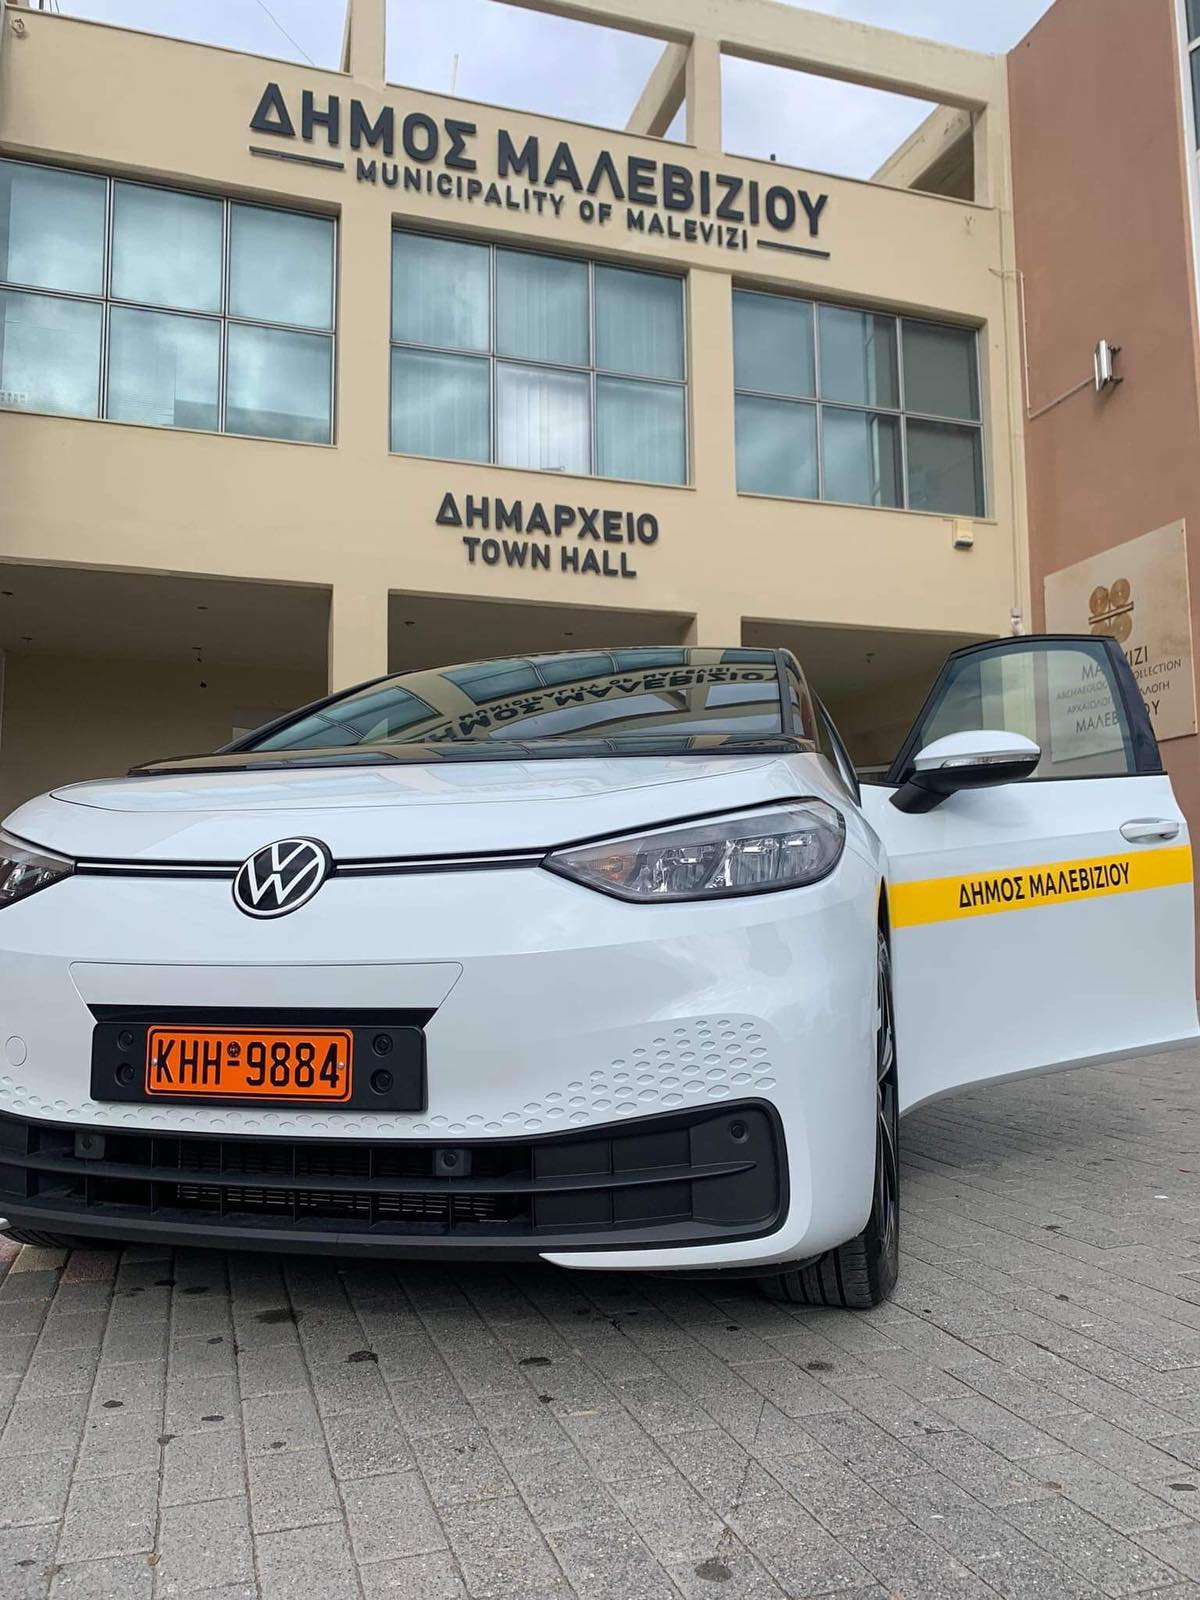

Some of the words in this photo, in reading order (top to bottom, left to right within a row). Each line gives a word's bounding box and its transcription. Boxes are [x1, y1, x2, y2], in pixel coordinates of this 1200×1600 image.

[249, 82, 477, 170] ΔΗΜΟΣ
[497, 128, 829, 236] ΜΑΛΕΒΙΖΙΟΥ
[356, 157, 565, 216] MUNICIPALITY
[579, 199, 612, 224] OF
[627, 208, 748, 250] MALEVIZI
[435, 492, 659, 544] ΔΗΜΑΡΧΕΙΟ
[462, 536, 550, 570] TOWN
[560, 546, 637, 578] HALL
[959, 876, 1026, 909] ΔΗΜΟΣ
[1029, 862, 1130, 898] ΜΑΛΕΒΙΖΙΟΥ
